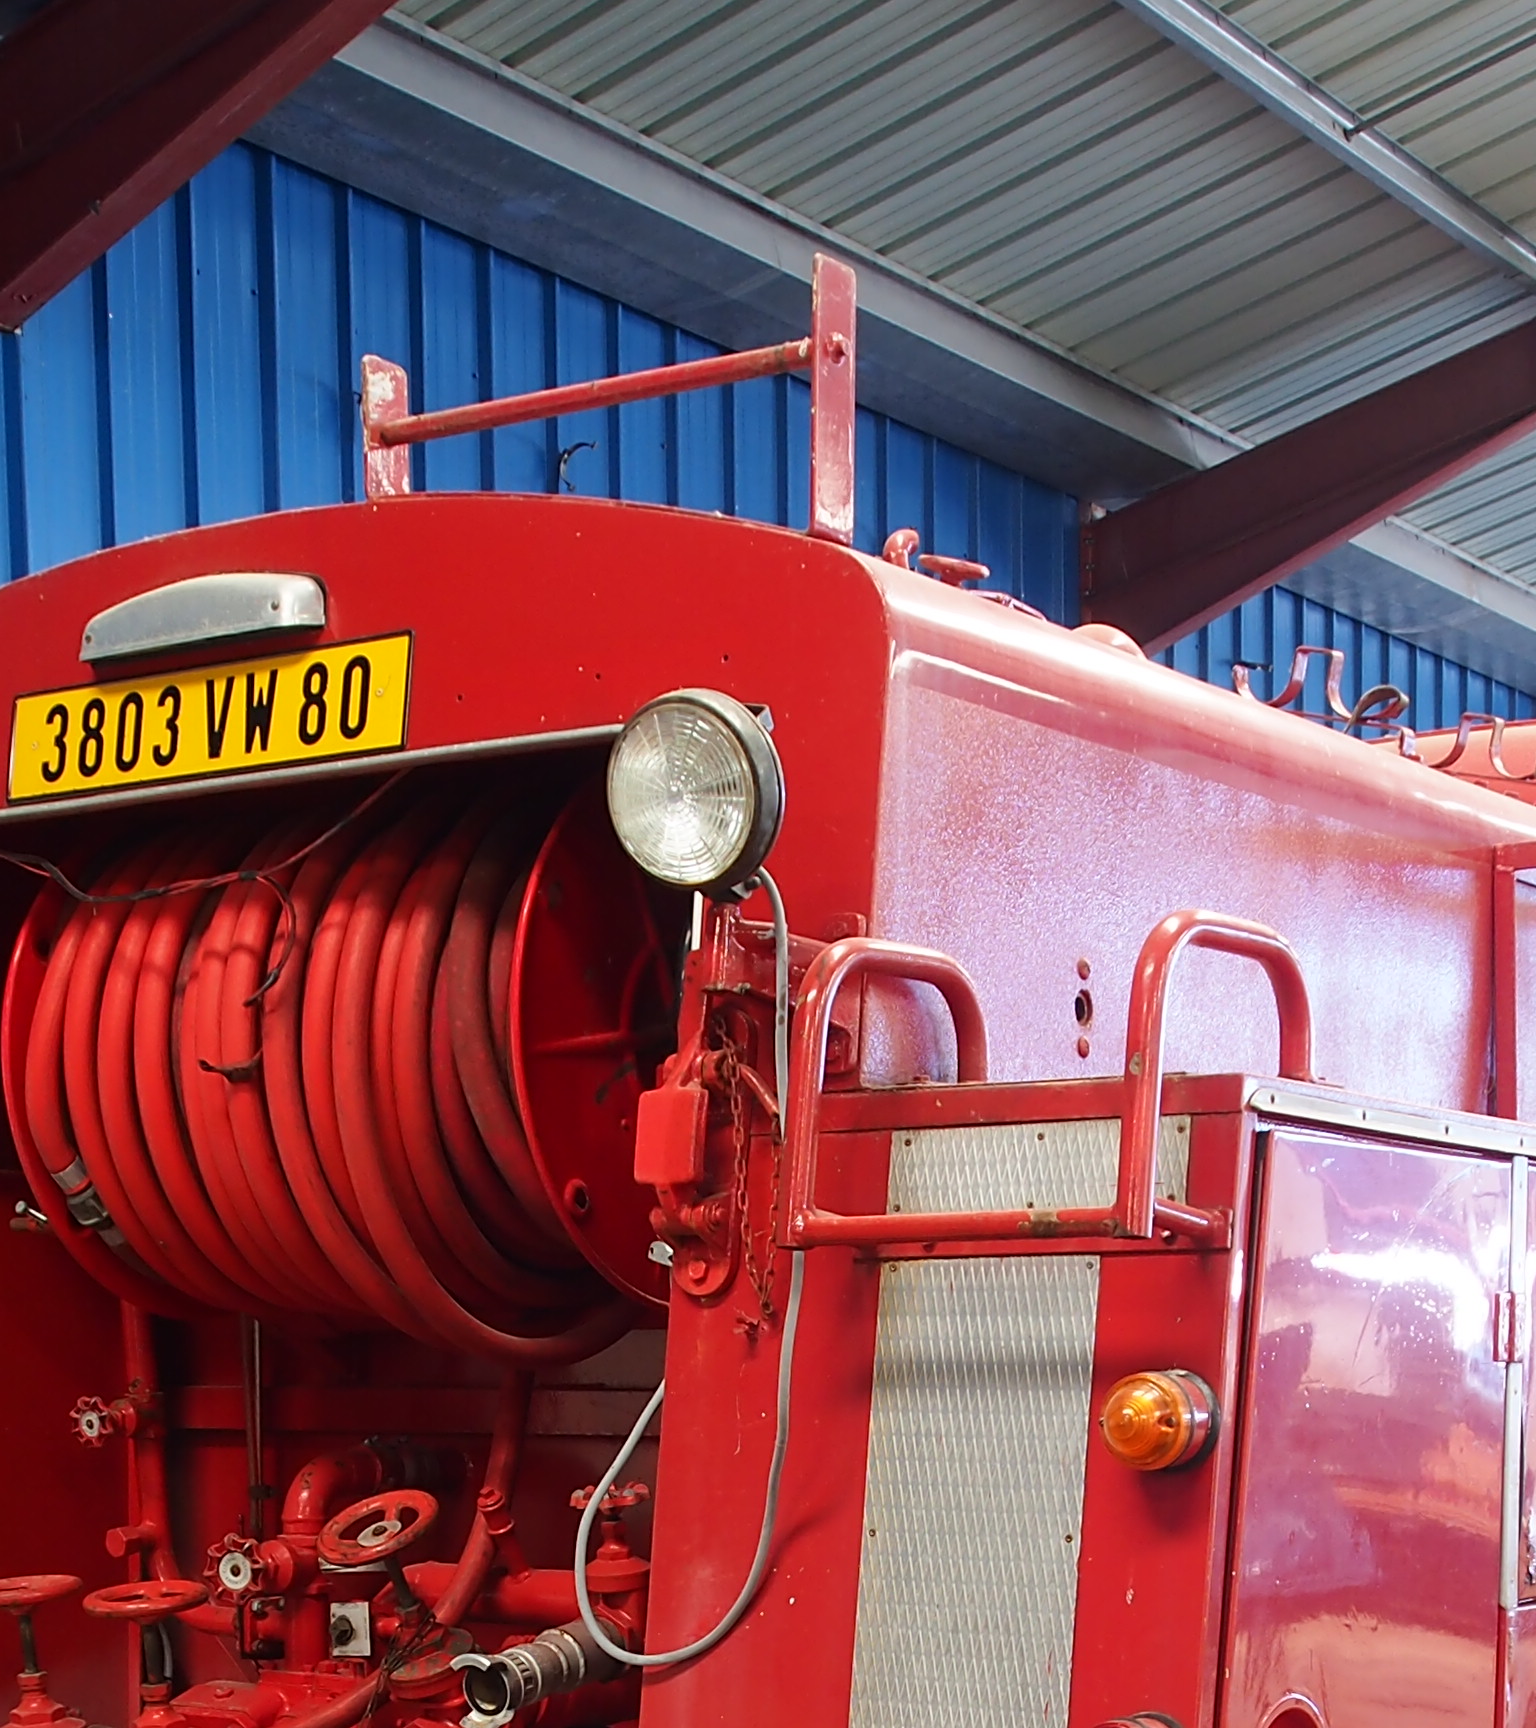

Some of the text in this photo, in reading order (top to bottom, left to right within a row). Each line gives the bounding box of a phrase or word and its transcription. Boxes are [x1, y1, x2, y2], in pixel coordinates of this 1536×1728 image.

[41, 653, 371, 783] 3803 VW 80
